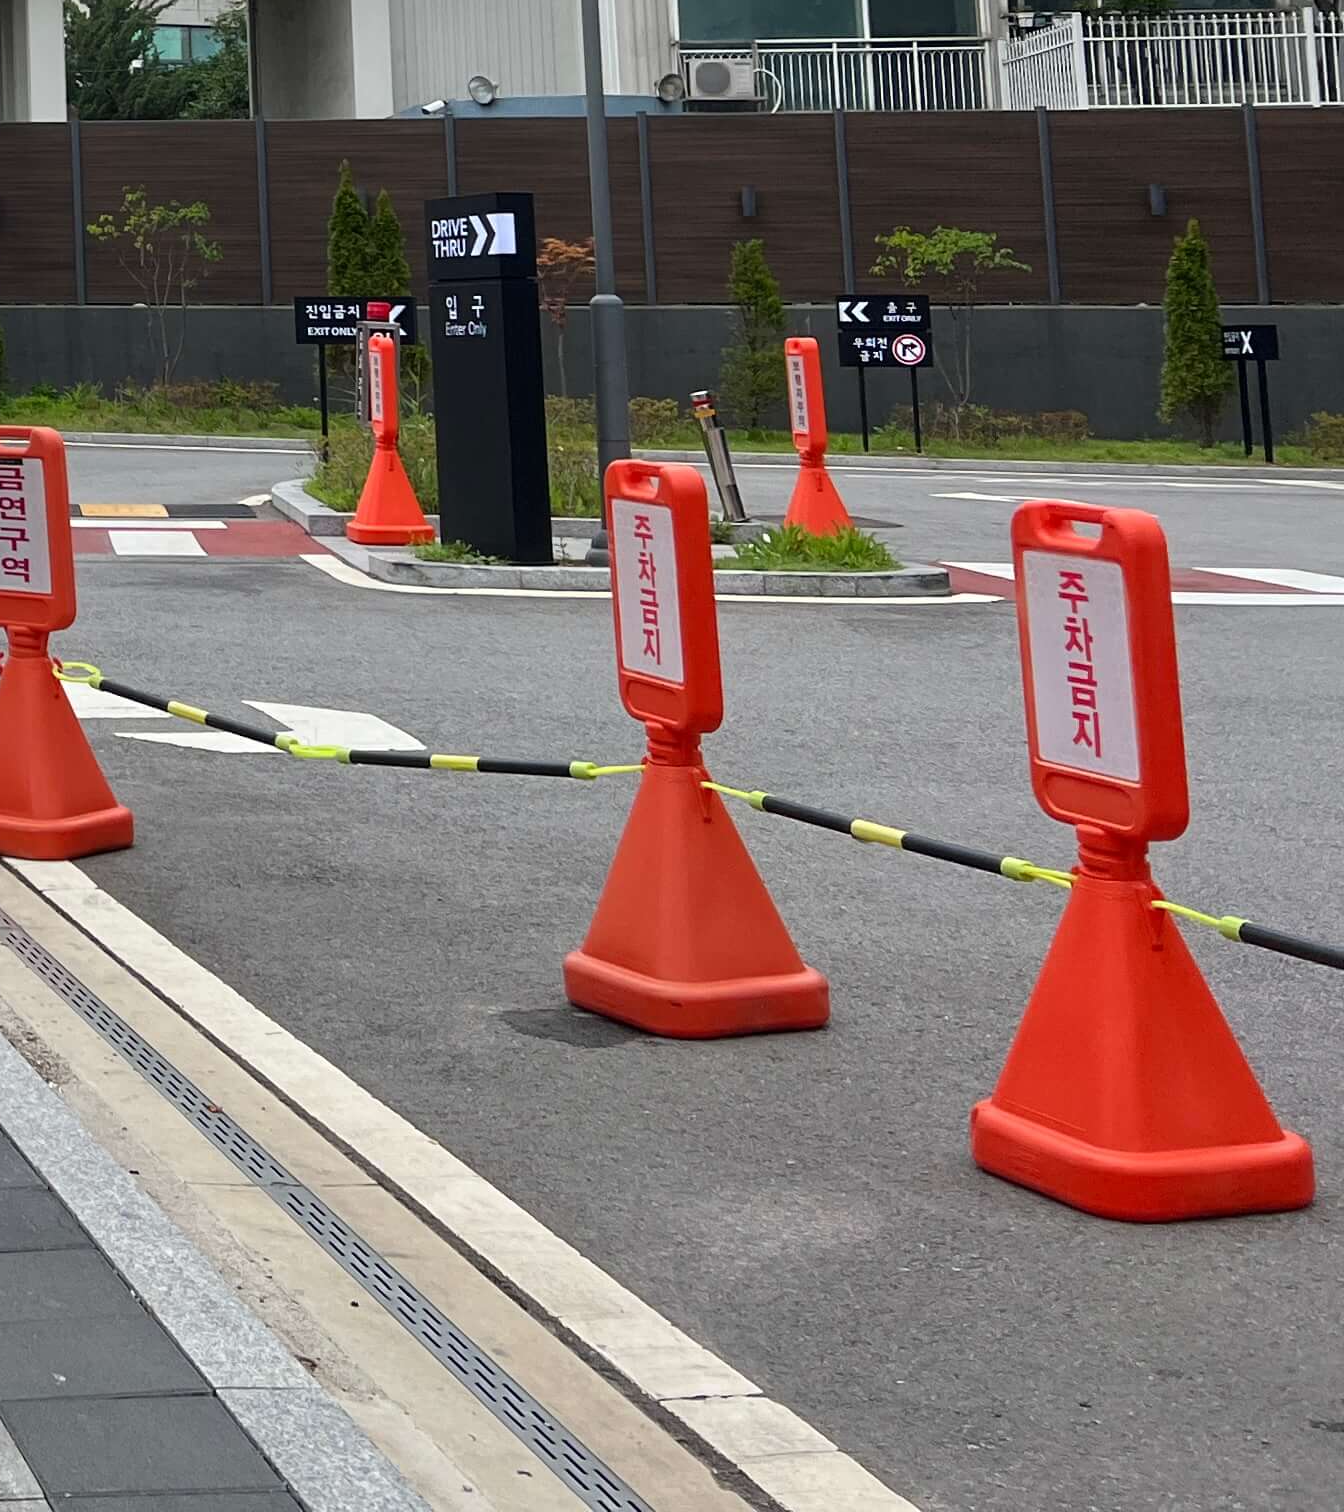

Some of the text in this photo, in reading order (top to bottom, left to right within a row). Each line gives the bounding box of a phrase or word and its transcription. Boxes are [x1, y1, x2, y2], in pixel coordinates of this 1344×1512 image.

[431, 218, 468, 239] DRIVE
[433, 238, 466, 258] THRU
[305, 304, 360, 319] 진입금지
[307, 327, 329, 336] EXIT
[445, 321, 487, 338] Enter Only
[853, 337, 888, 349] 우회전
[859, 350, 883, 362] 금지
[634, 515, 660, 666] 주차금지
[1058, 571, 1101, 759] 주차금지
